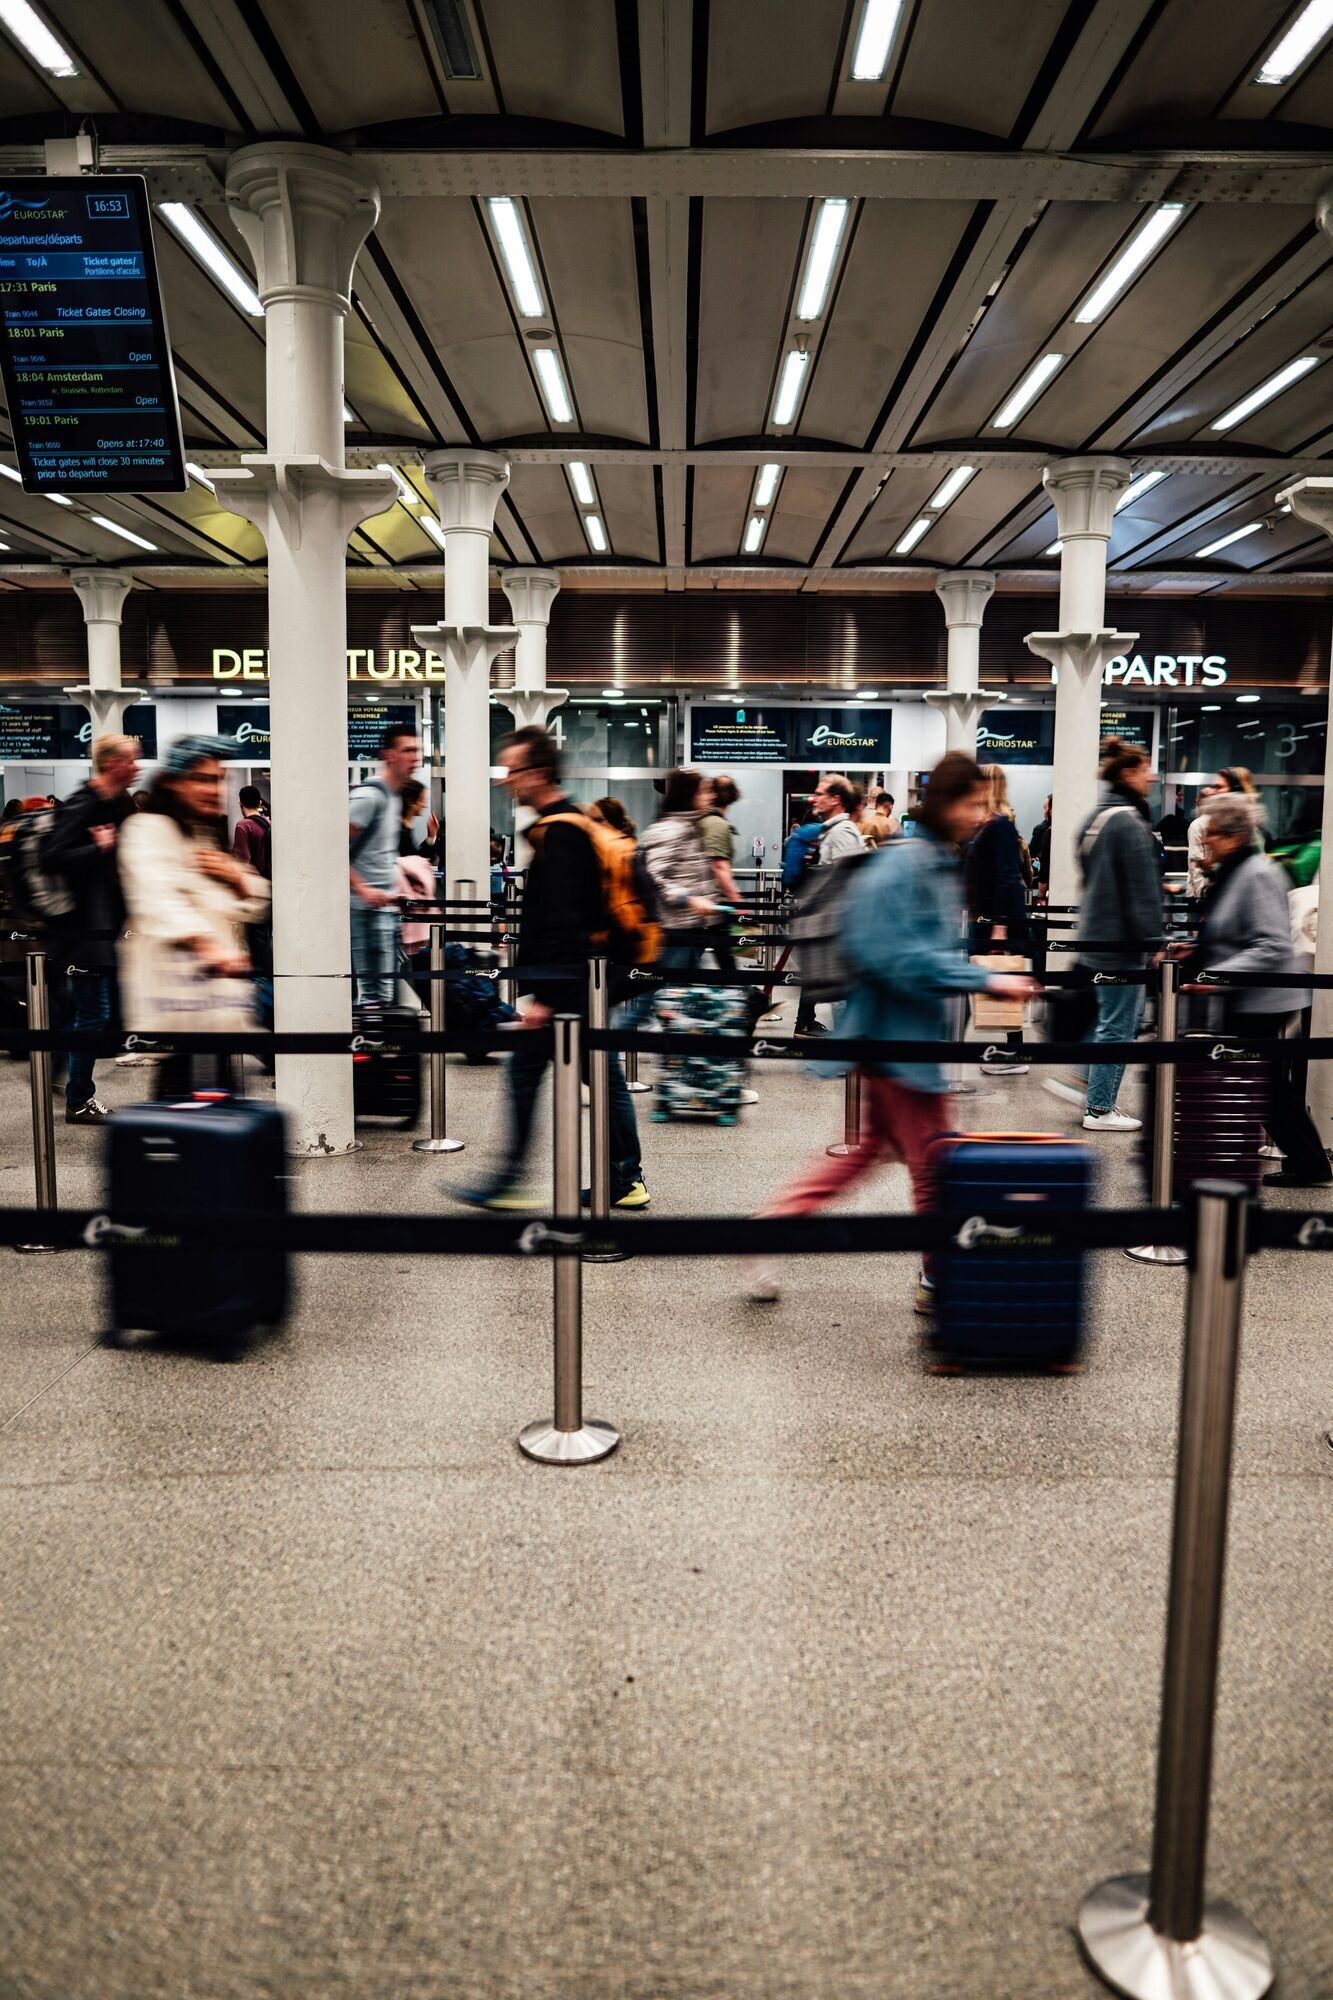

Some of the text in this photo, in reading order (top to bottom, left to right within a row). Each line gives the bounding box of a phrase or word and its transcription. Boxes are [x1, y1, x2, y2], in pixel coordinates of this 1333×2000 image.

[95, 201, 122, 212] 16:53
[14, 210, 65, 219] EUROSTAR
[0, 256, 48, 267] ime To/À
[83, 257, 136, 268] Ticket gates/
[85, 267, 115, 276] Portillons
[0, 281, 57, 293] 17:31 Paris
[5, 310, 21, 318] Train
[56, 306, 146, 318] Ticket Gates Closing
[8, 327, 65, 338] 18:01 Paris
[13, 355, 29, 363] Train
[128, 351, 152, 362] Open
[16, 371, 103, 382] 18:04 Amsterdam
[21, 399, 37, 407] Train
[135, 395, 158, 405] Open
[24, 415, 80, 425] 19:01 Paris
[97, 438, 165, 449] Opens at:17:40
[32, 456, 165, 469] Ticket gates will close 30 minutes
[38, 469, 108, 480] prior to departure
[1052, 654, 1228, 686] PARTS
[546, 715, 567, 750] 4
[827, 738, 875, 747] EUROSTAR
[986, 739, 1034, 749] EUROSTAR
[1275, 723, 1297, 758] 3
